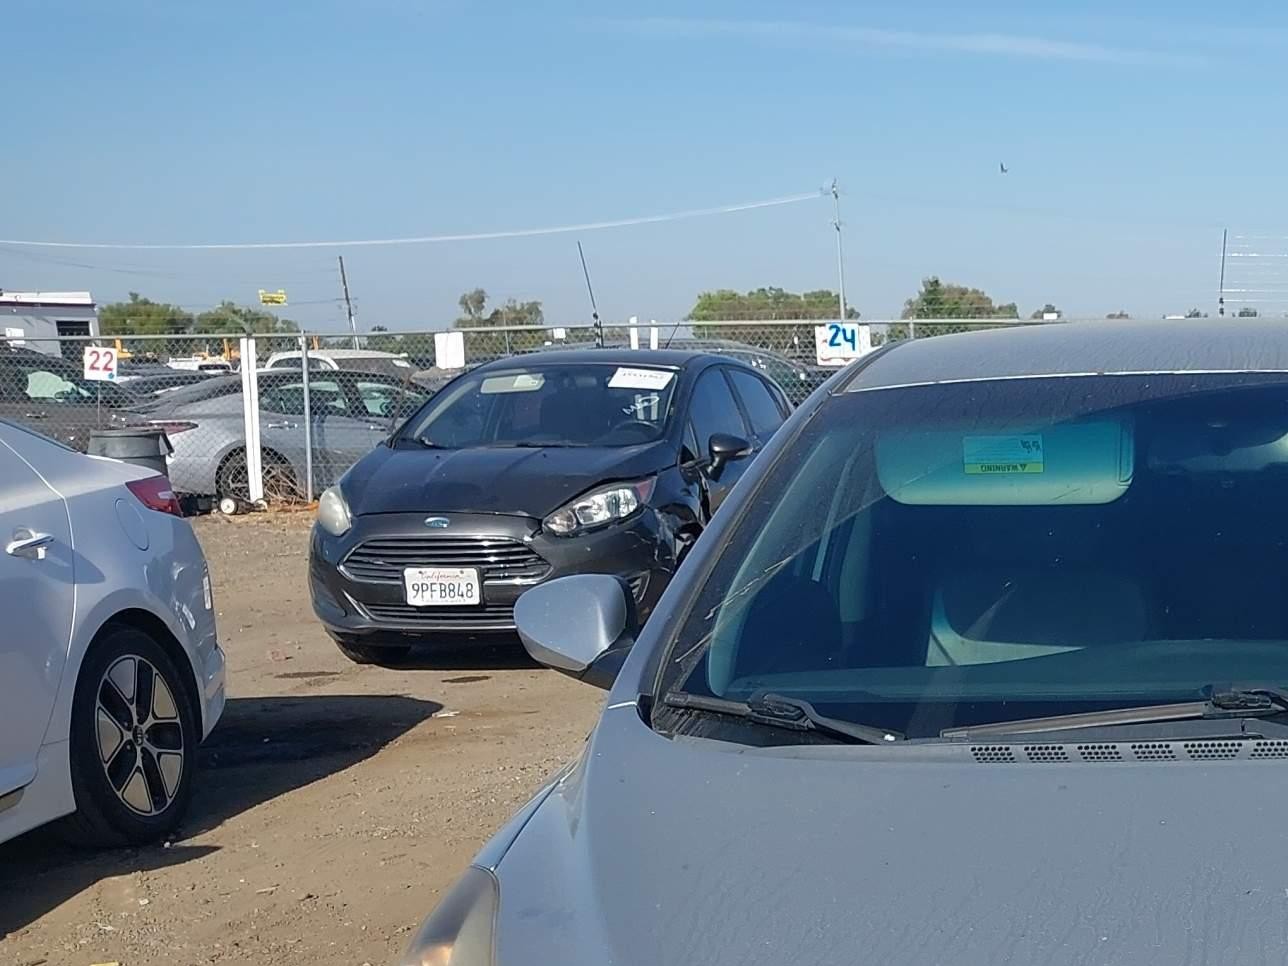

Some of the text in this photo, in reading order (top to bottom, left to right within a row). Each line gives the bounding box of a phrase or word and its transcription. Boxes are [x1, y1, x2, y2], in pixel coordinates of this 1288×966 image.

[828, 324, 856, 352] 24
[88, 350, 114, 372] 22
[411, 582, 474, 600] 9PFB848
